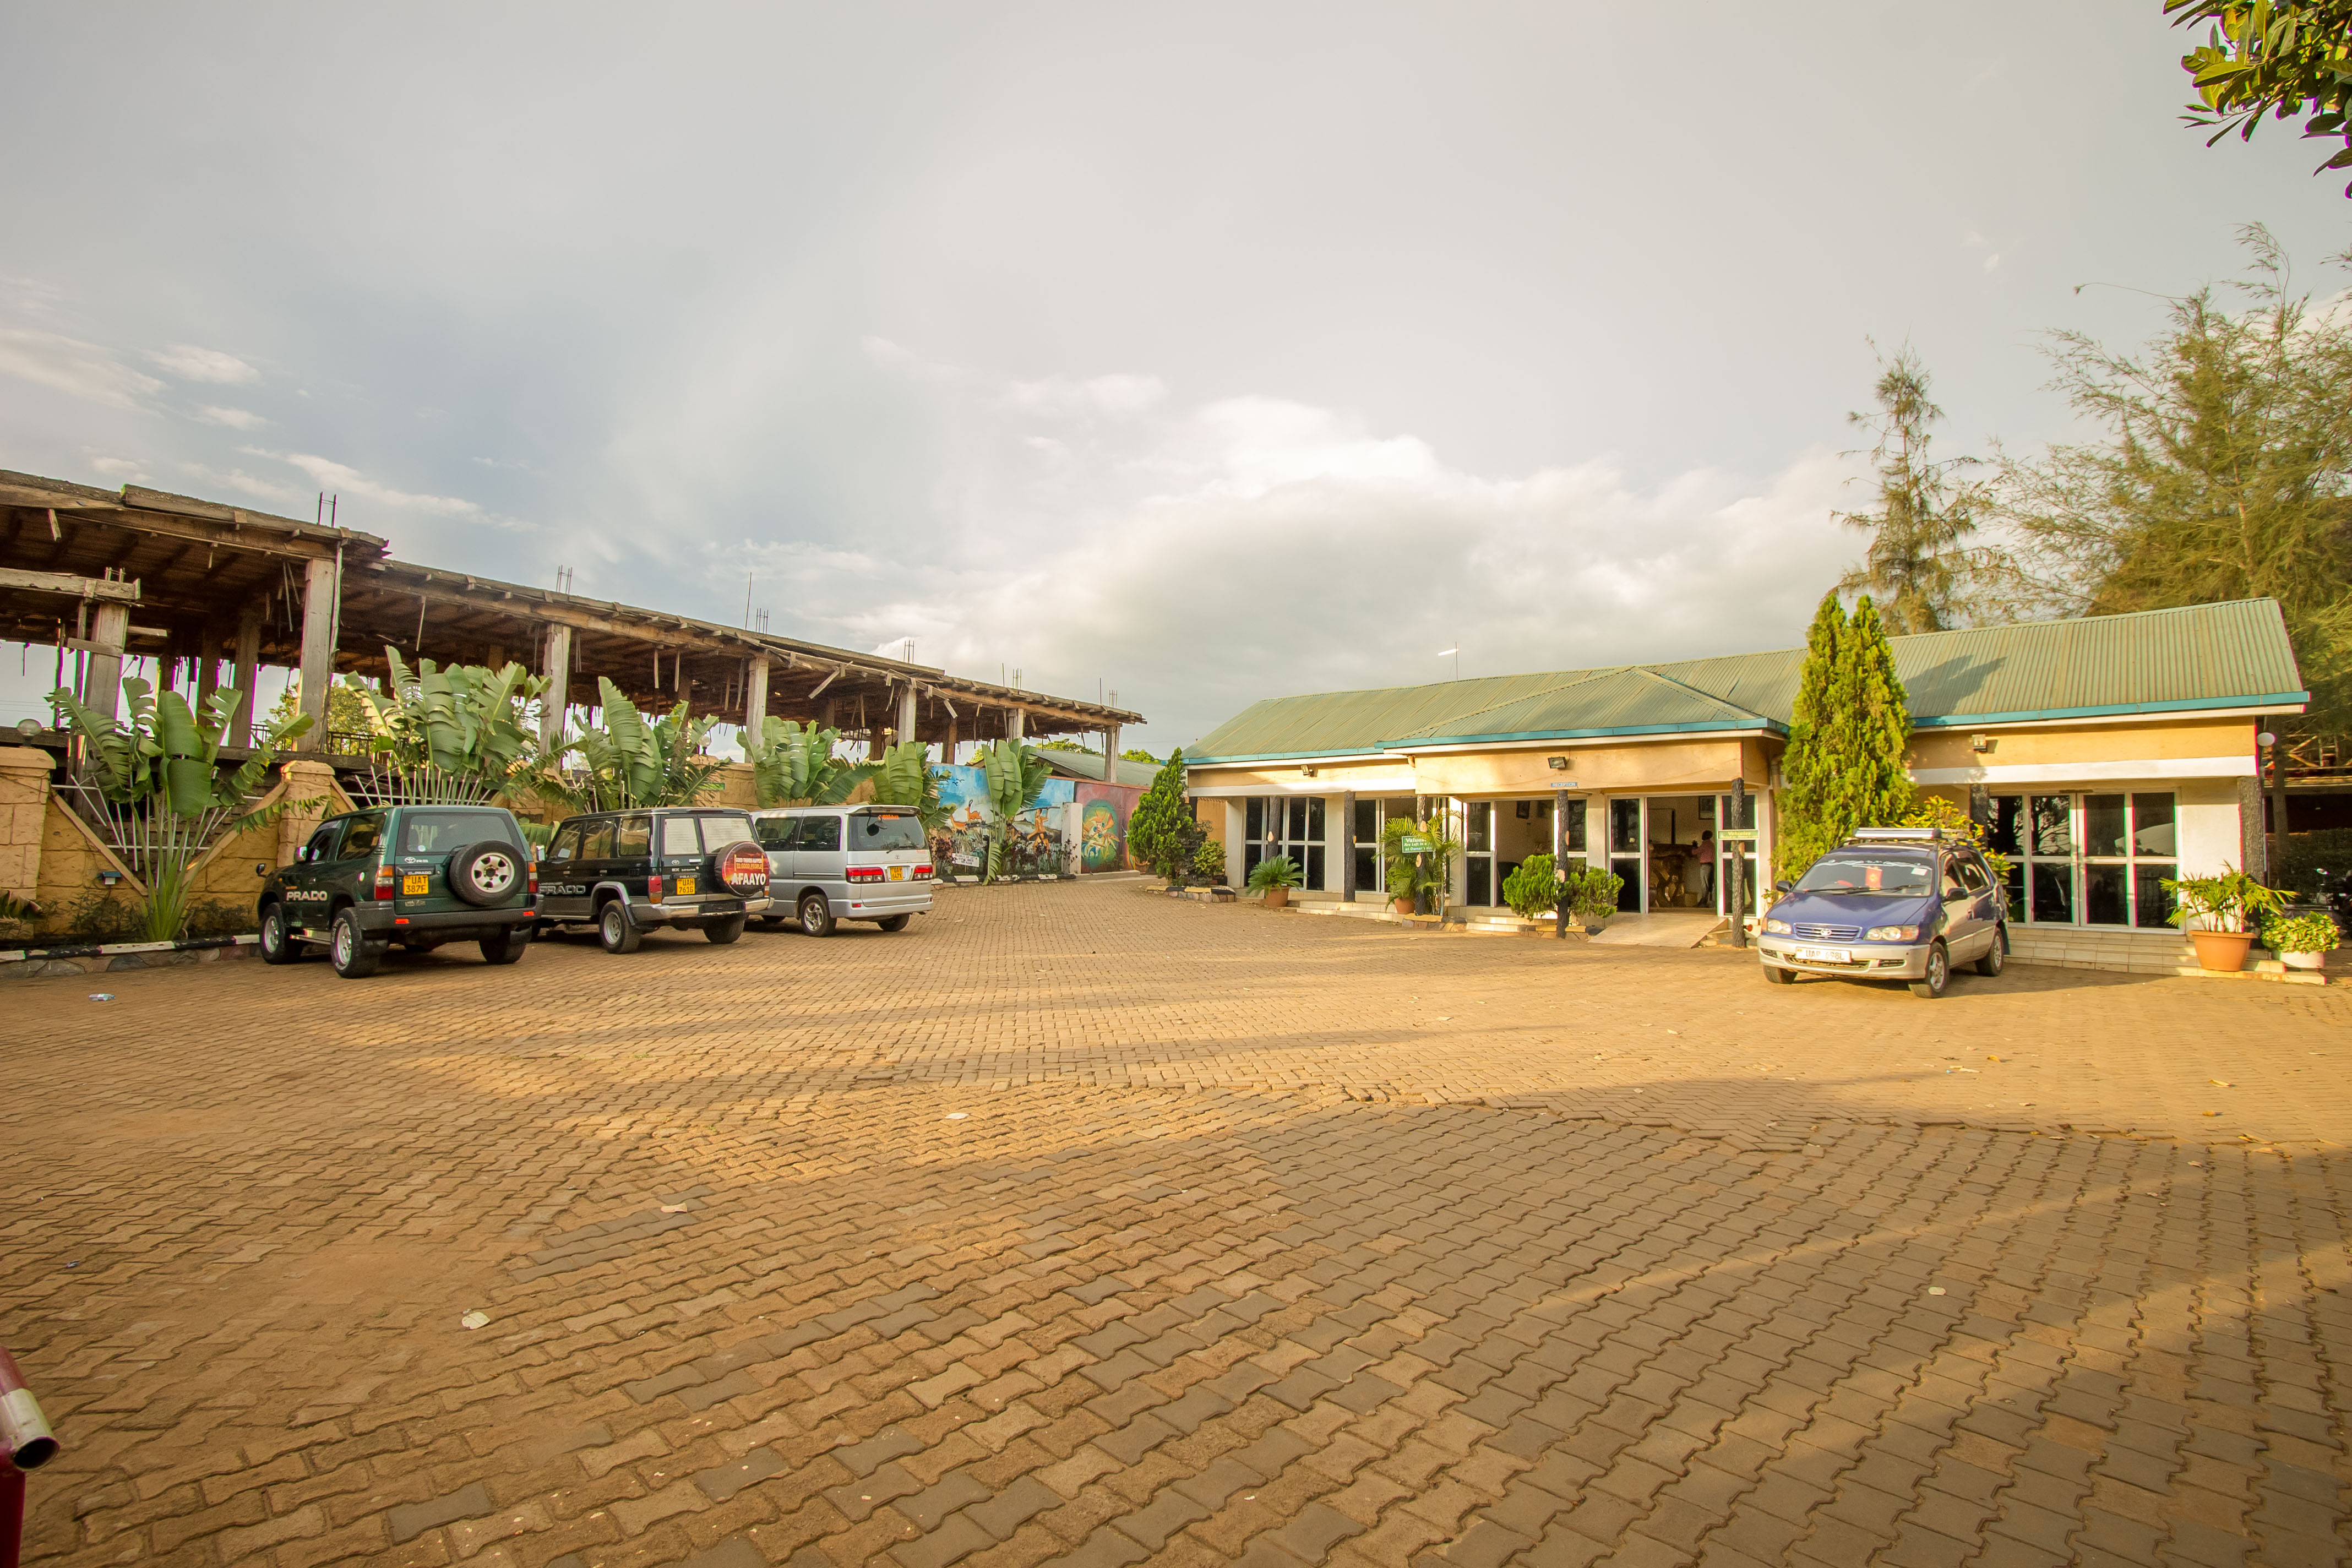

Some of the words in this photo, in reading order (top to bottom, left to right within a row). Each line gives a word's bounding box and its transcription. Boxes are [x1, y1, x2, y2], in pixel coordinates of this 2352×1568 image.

[731, 873, 766, 885] AFAAYO
[538, 885, 585, 894] PRADO
[286, 891, 328, 901] PRADO
